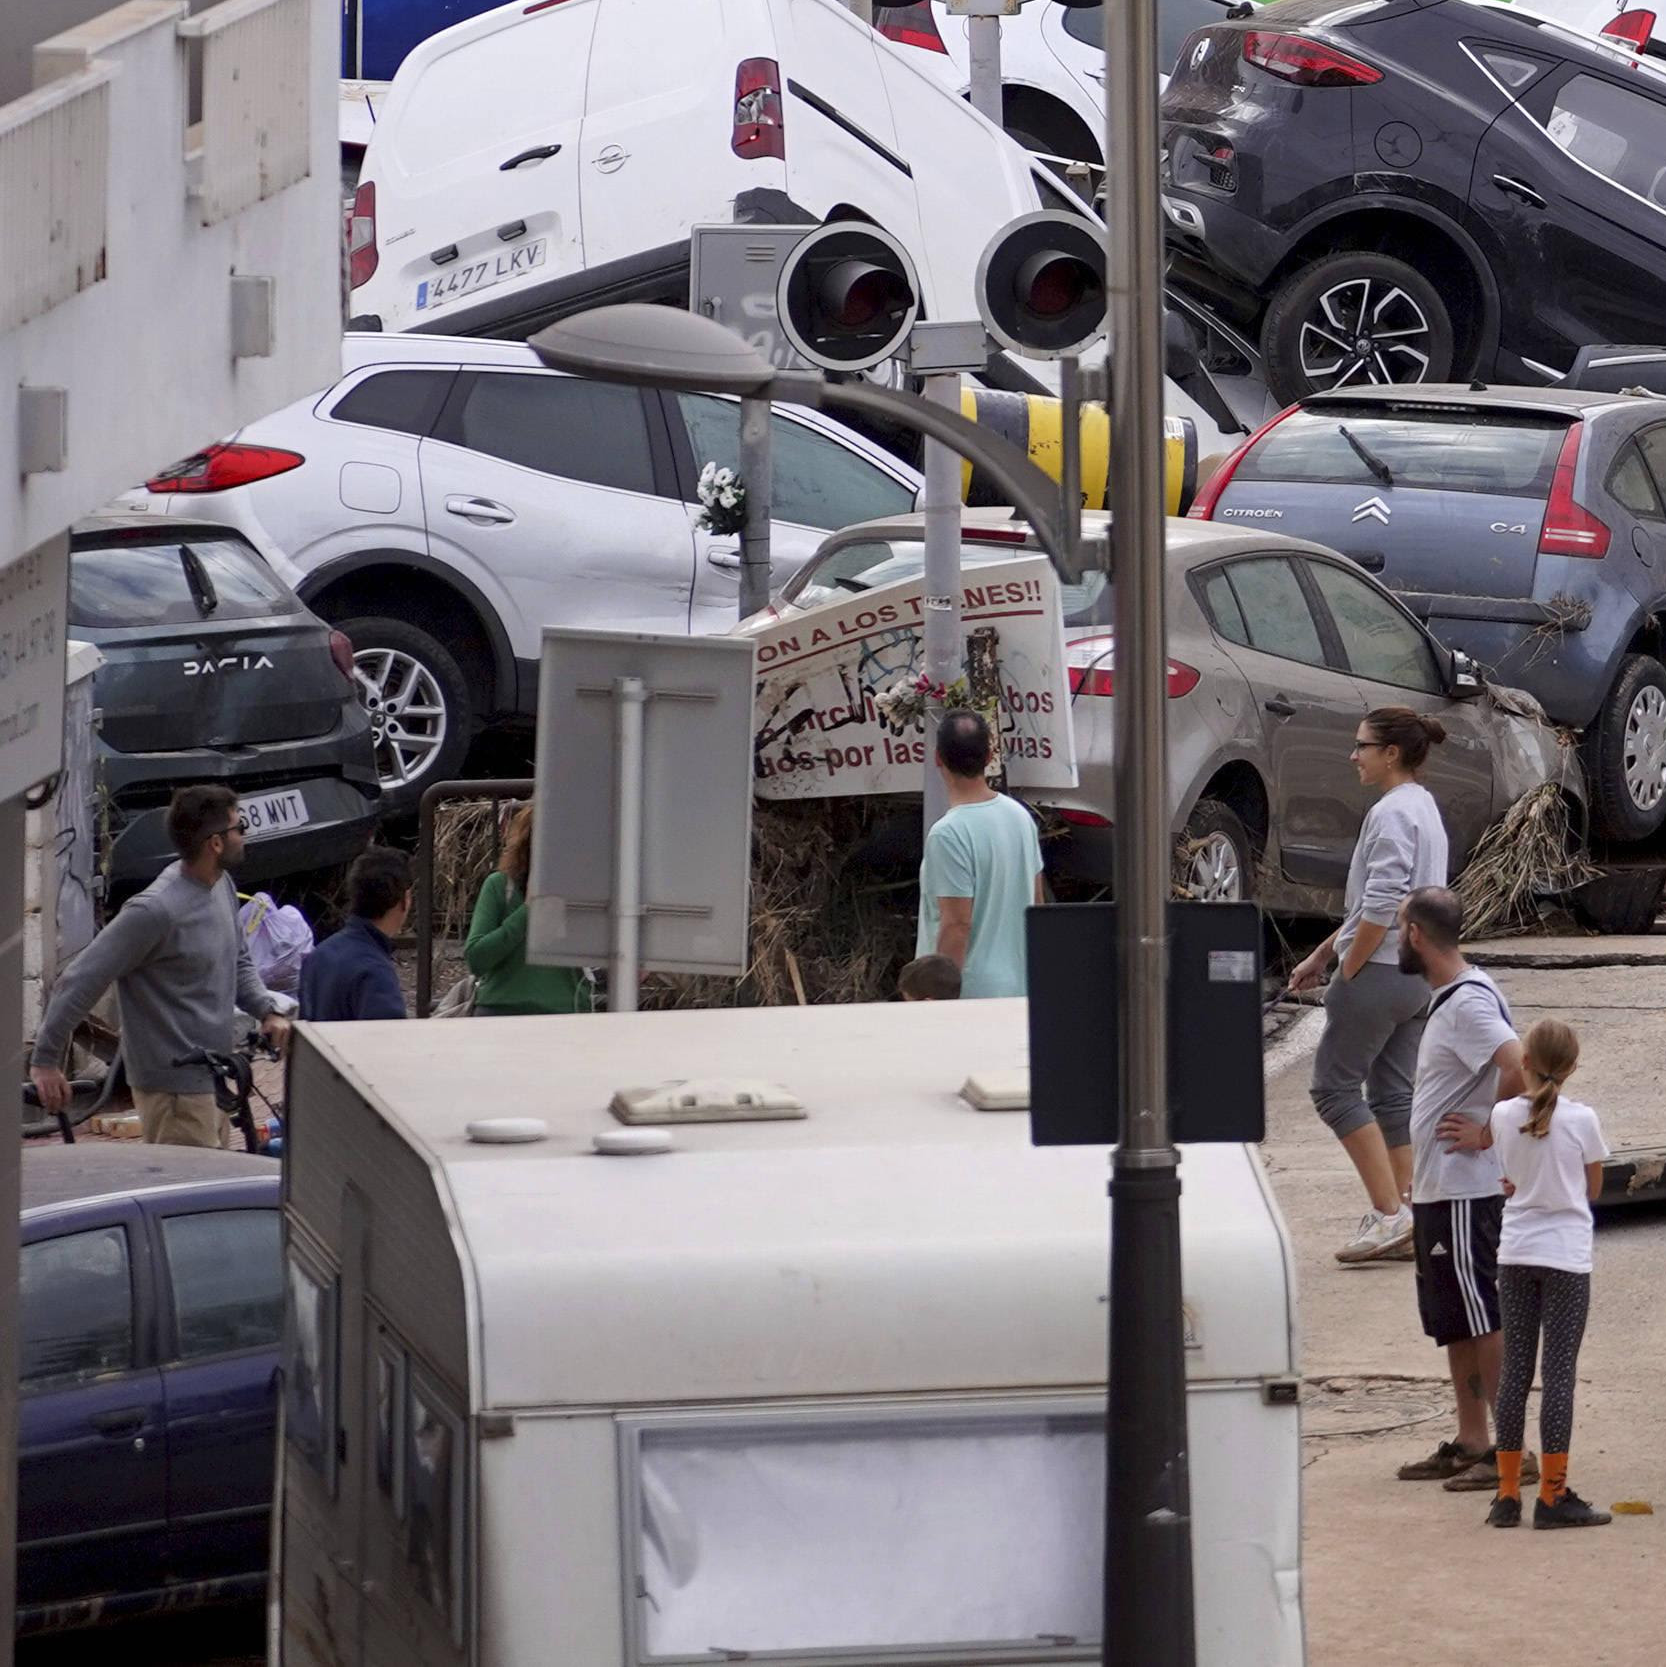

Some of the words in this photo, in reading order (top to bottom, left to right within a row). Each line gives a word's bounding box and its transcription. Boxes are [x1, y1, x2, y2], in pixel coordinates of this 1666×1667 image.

[433, 262, 489, 297] 4477
[496, 245, 539, 276] LKV
[1223, 507, 1284, 519] CITROËN
[1490, 521, 1528, 535] C4
[811, 627, 832, 646] A
[837, 604, 898, 637] LOS
[903, 580, 1043, 615] TNES!!
[183, 655, 274, 676] DACIA
[824, 745, 874, 777] por
[883, 737, 925, 765] las
[264, 795, 300, 825] MVT
